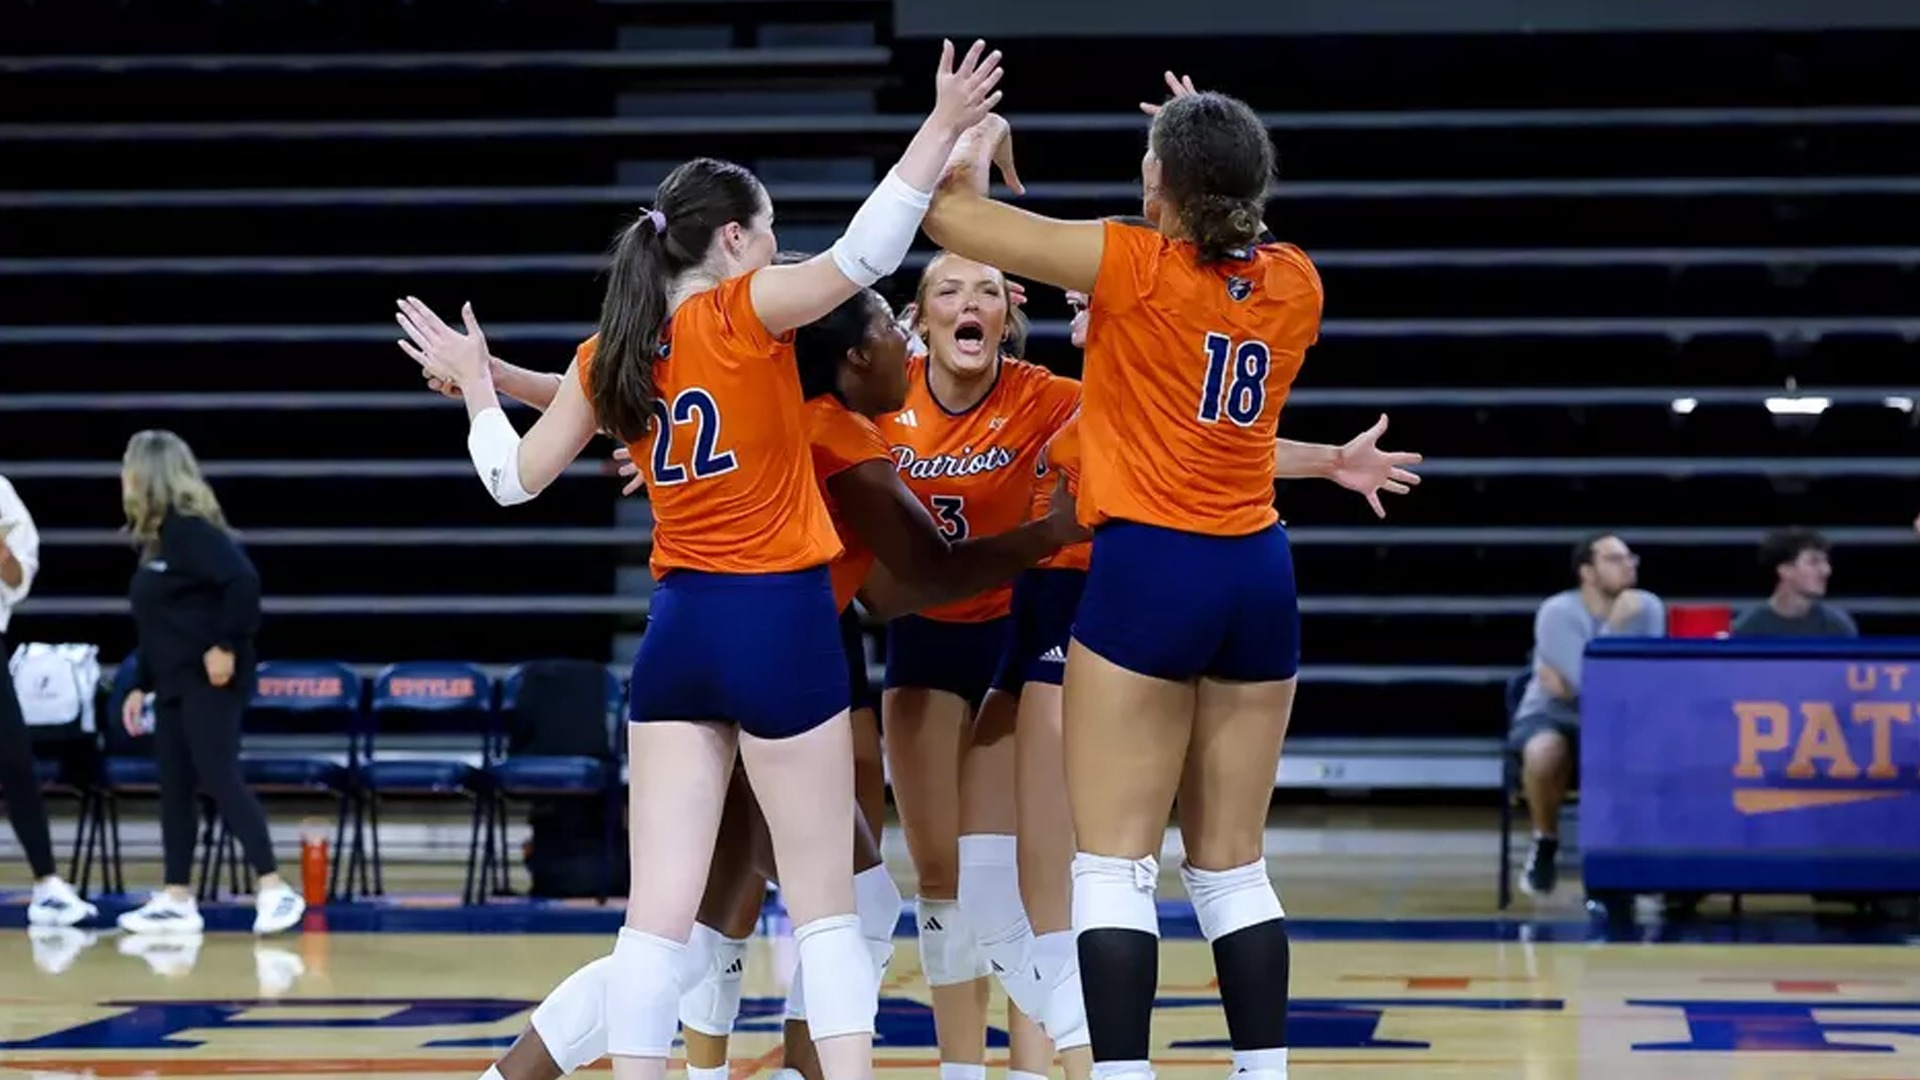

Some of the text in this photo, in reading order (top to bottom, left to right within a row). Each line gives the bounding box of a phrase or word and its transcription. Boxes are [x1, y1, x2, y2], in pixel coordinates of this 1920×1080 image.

[1197, 331, 1270, 427] 18
[645, 387, 739, 486] 22
[889, 445, 1017, 479] Patriots
[931, 495, 969, 543] 3
[1847, 665, 1909, 691] UT
[1734, 702, 1920, 779] PAT
